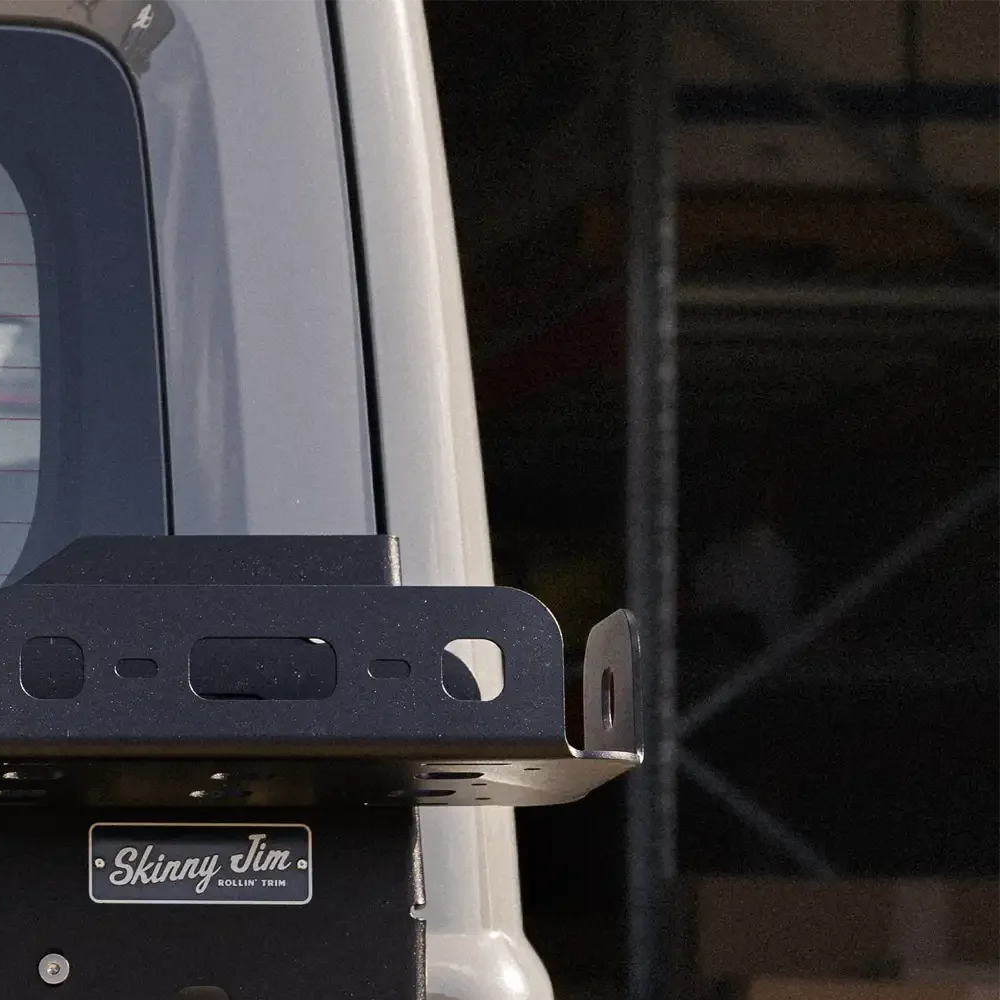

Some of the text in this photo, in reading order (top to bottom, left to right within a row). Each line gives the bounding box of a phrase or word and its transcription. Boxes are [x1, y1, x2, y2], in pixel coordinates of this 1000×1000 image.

[109, 833, 292, 894] Skinny Jim
[218, 879, 286, 887] ROLLIN' TRIM
